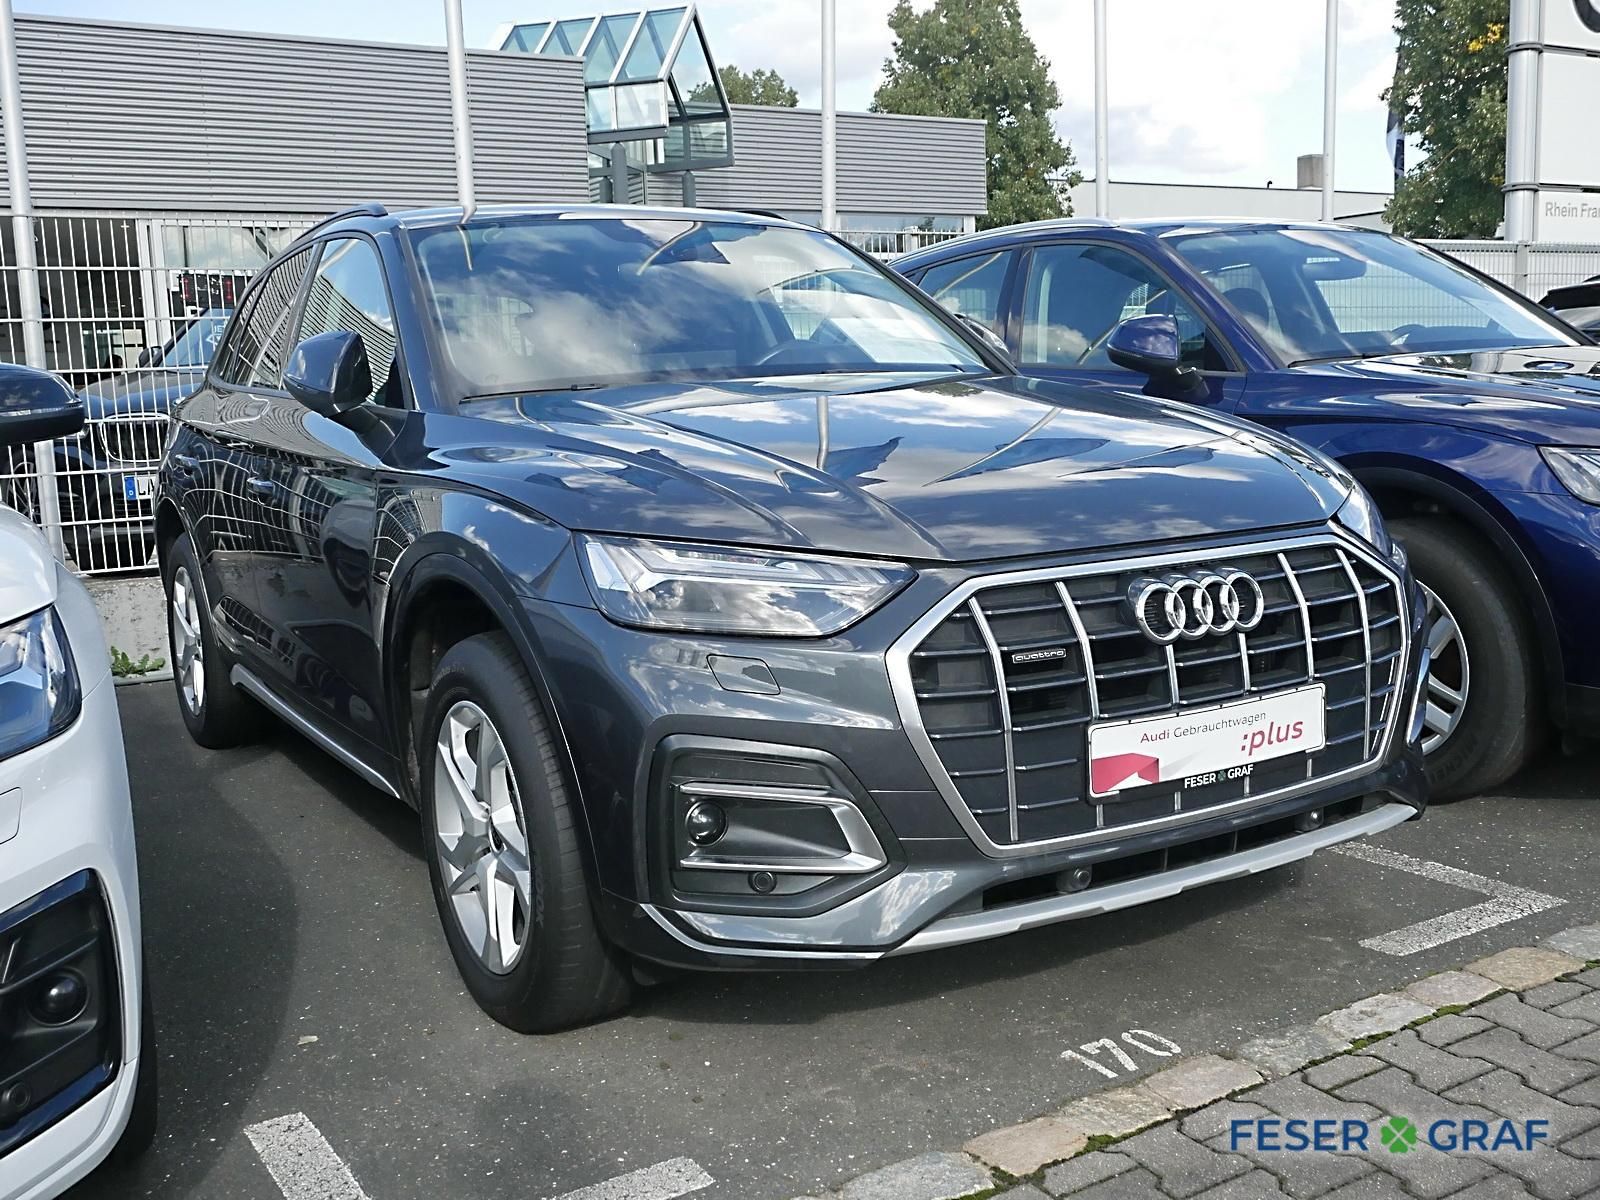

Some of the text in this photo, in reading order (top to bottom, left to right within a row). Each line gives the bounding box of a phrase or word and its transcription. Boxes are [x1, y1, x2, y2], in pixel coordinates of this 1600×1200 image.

[1545, 202, 1600, 217] Rhein Fra
[1015, 650, 1064, 661] quattro
[1140, 711, 1267, 744] Audi Gebrauchtwagen
[1240, 720, 1304, 756] :plus
[1184, 764, 1254, 789] FESER GRAF
[1060, 1029, 1182, 1078] 170
